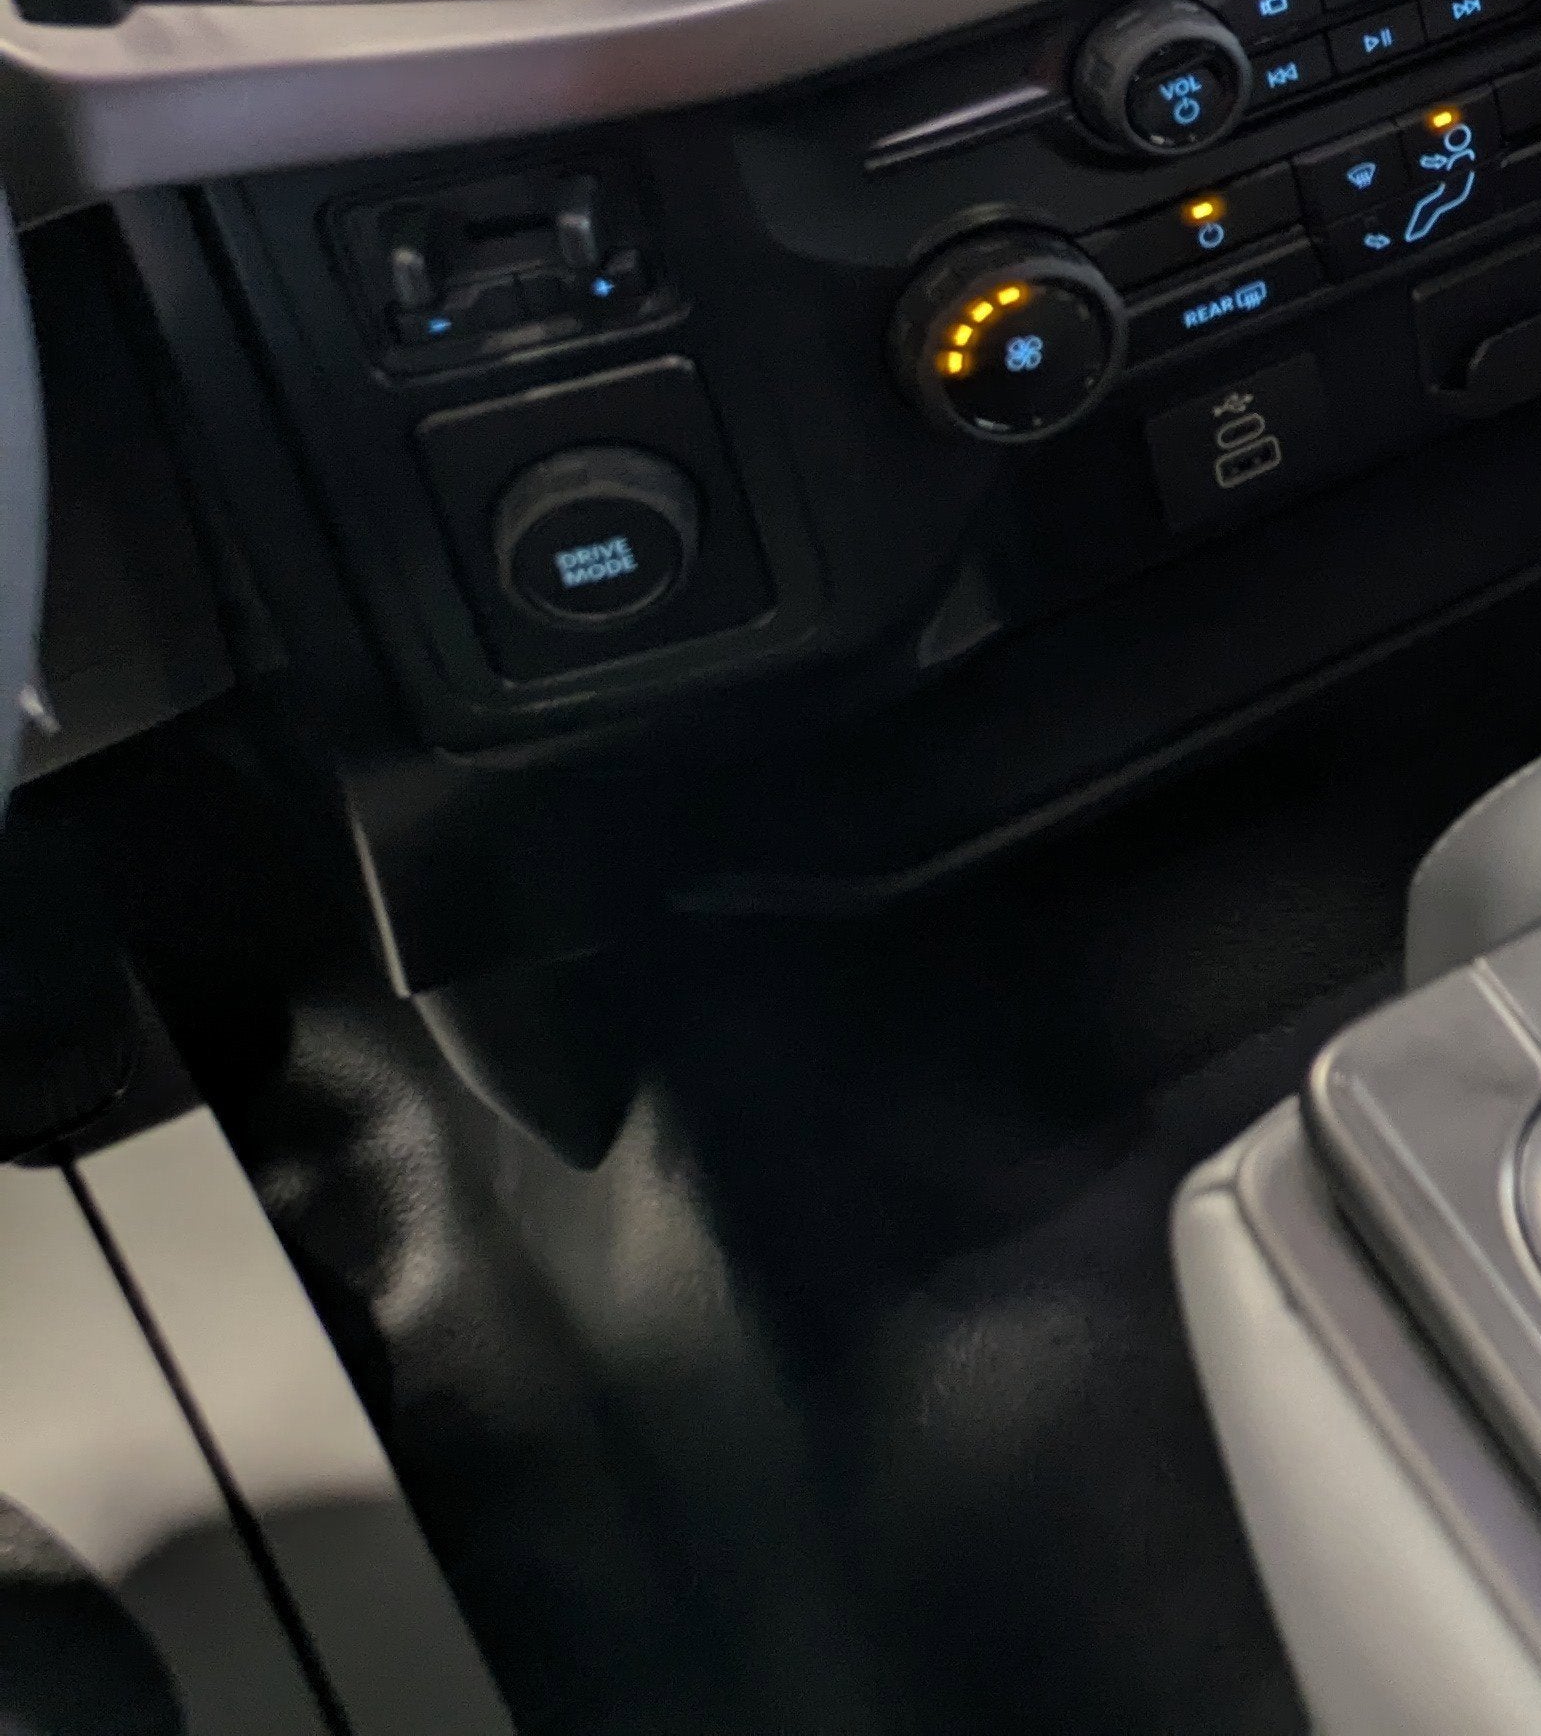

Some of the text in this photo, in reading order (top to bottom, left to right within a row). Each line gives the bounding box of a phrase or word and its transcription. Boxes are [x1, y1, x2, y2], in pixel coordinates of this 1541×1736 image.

[1159, 73, 1202, 101] VOL
[1183, 294, 1234, 329] REAR
[555, 535, 632, 568] DRIVE
[561, 554, 638, 589] MODE
